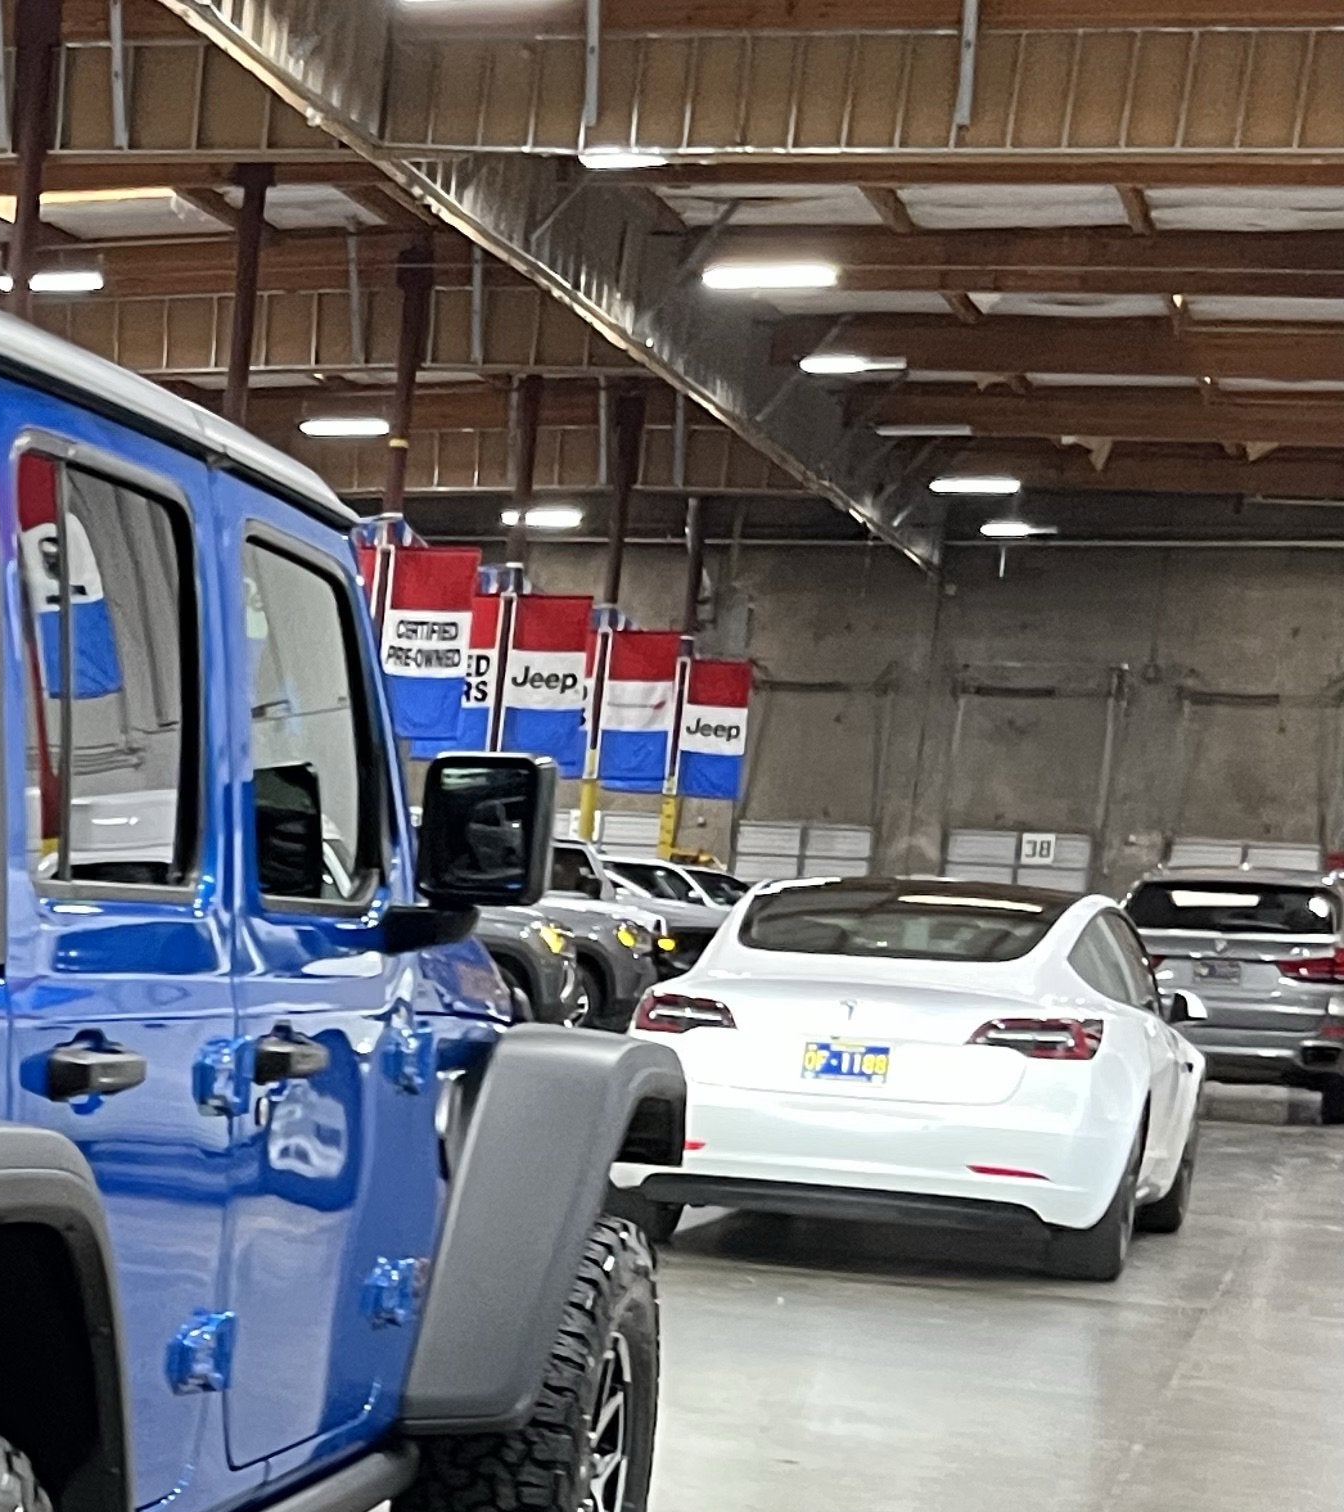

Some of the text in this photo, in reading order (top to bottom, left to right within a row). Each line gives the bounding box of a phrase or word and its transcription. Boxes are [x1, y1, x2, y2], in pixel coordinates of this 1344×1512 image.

[396, 619, 459, 642] CERTIFIED
[385, 645, 461, 668] PRE-OWNED
[510, 665, 578, 695] Jeep
[685, 717, 741, 742] Jeep
